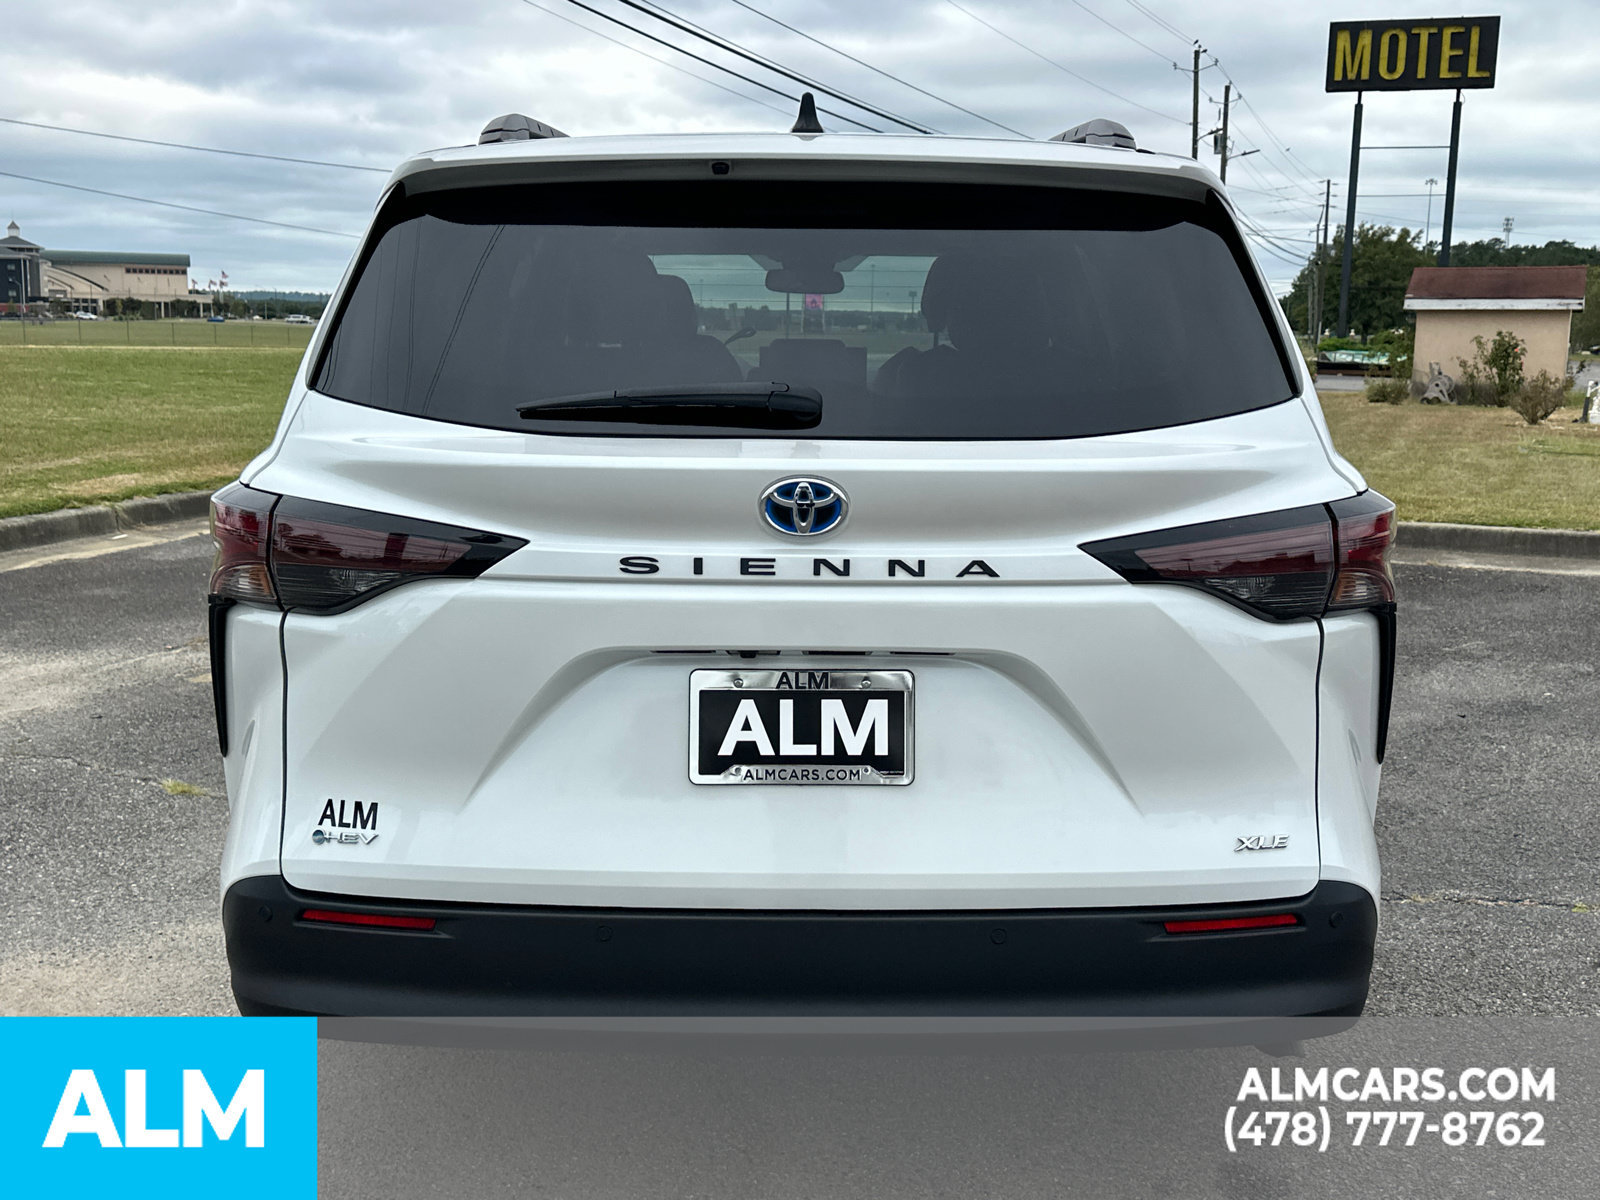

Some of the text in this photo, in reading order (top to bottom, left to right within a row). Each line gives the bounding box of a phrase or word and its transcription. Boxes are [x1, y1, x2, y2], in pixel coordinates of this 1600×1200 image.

[1333, 25, 1491, 82] MOTEL
[618, 555, 1001, 578] SIENNA
[775, 671, 830, 690] ALM
[717, 699, 889, 756] ALM
[743, 768, 861, 781] ALMCARS.COM
[317, 798, 379, 831] ALM
[1234, 834, 1290, 852] XLE
